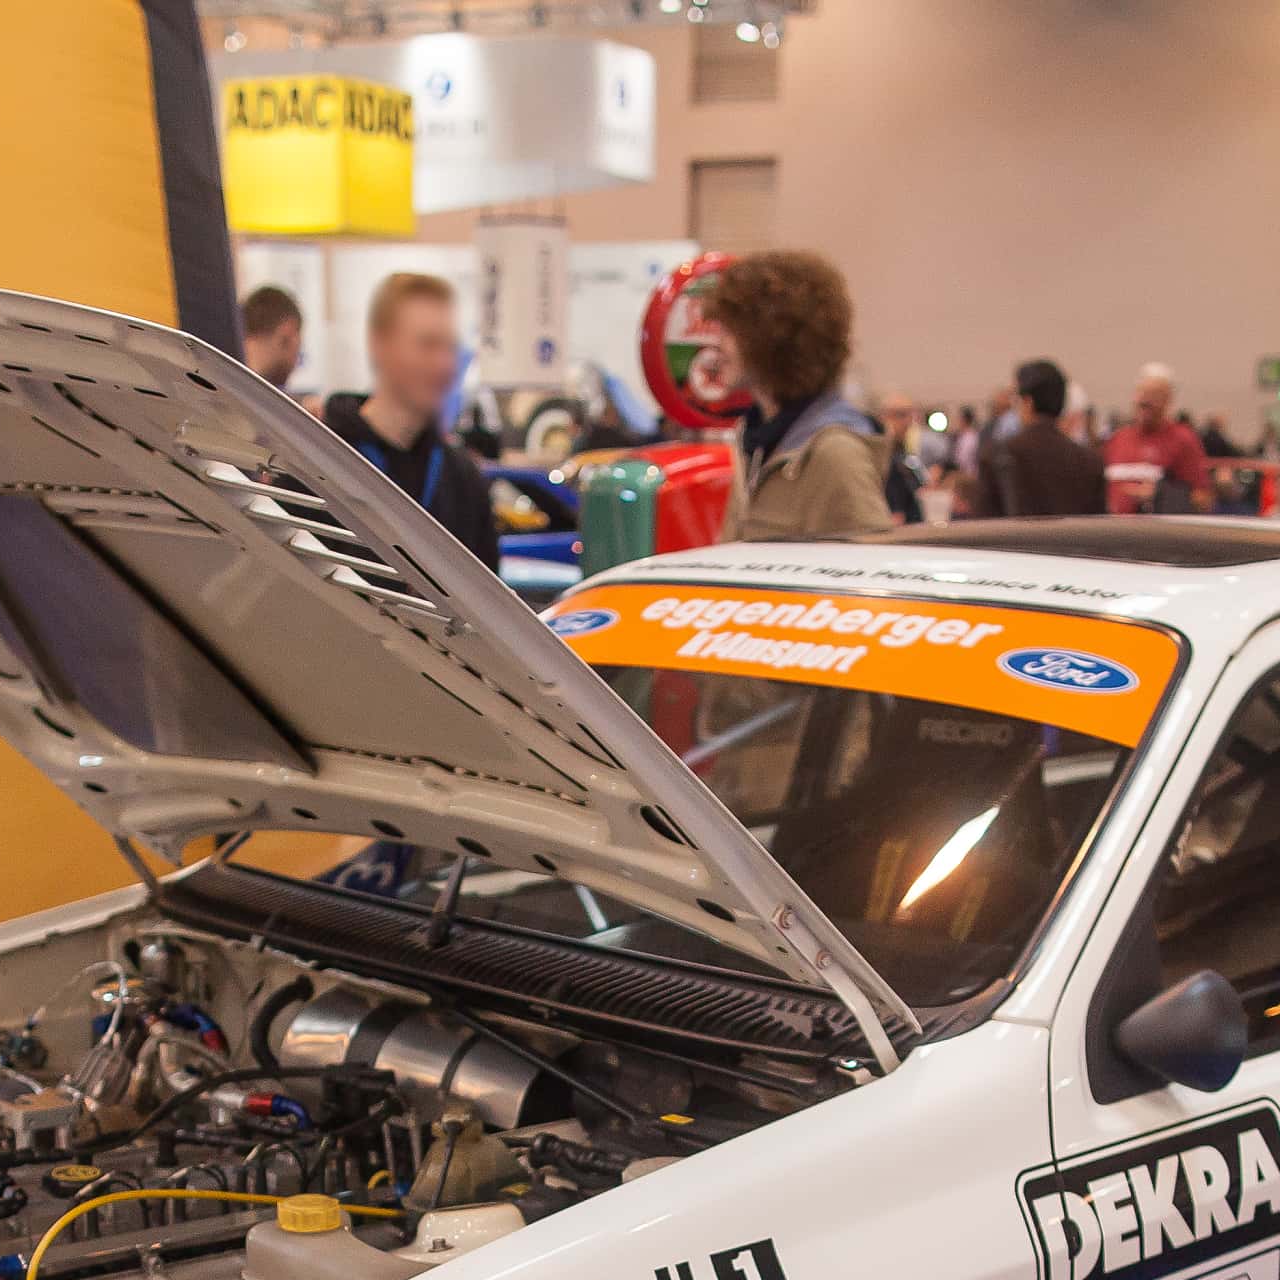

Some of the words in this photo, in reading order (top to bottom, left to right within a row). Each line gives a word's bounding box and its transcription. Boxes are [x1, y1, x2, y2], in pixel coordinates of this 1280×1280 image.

[228, 86, 336, 131] ADAC
[869, 568, 1039, 591] Perfoance
[641, 595, 1005, 648] eggenberger
[1020, 650, 1113, 688] Ford
